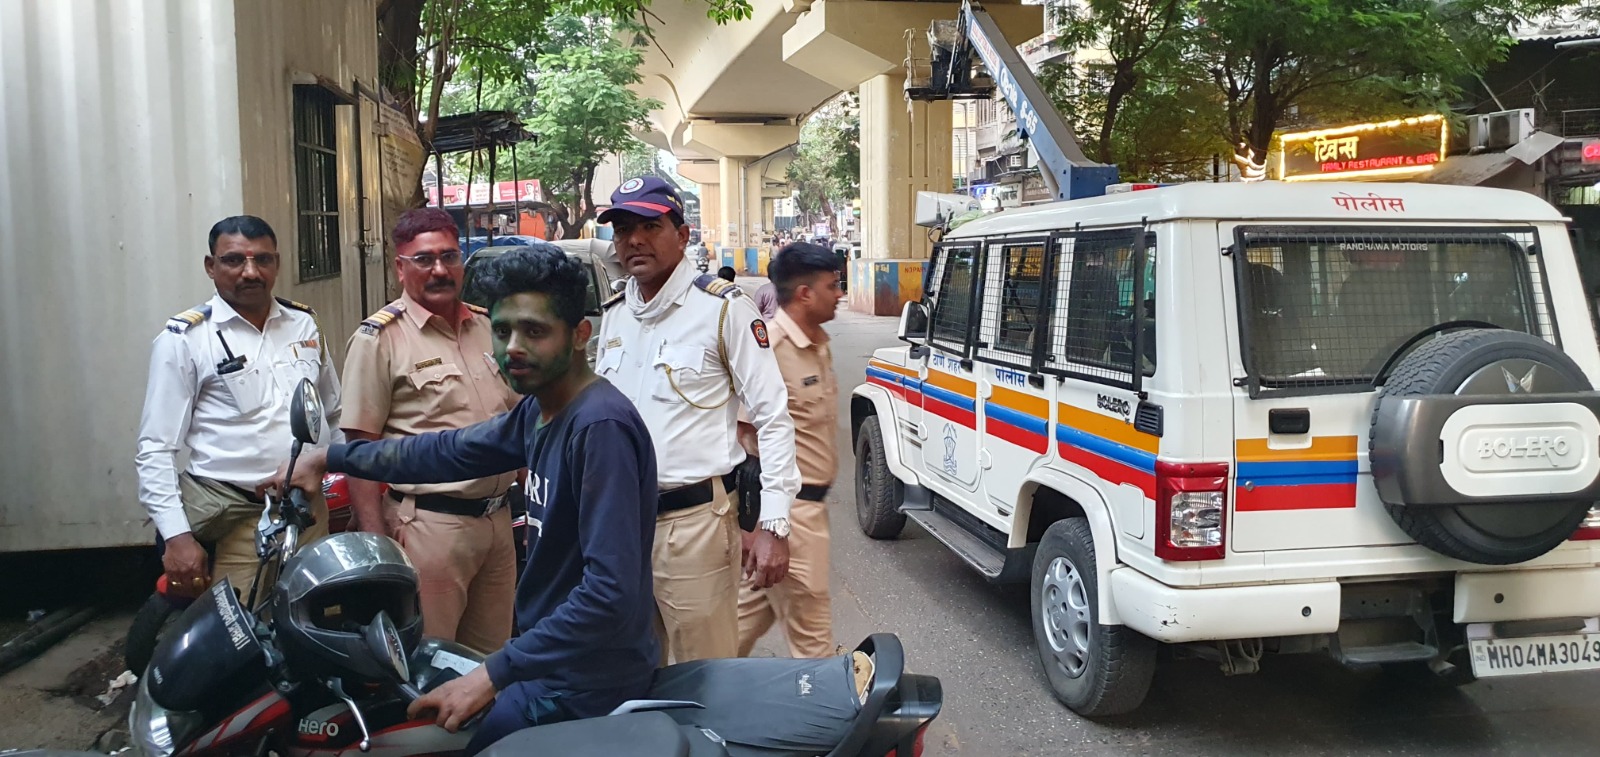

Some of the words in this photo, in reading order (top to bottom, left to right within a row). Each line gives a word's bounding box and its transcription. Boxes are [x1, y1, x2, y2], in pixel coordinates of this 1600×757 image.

[1321, 161, 1347, 172] FAMILY
[1347, 155, 1404, 169] RESTAURANT
[1405, 156, 1415, 164] &
[1331, 191, 1405, 212] पोलीस
[1391, 243, 1428, 251] MOTORS
[995, 365, 1026, 388] पोलीस
[1097, 393, 1131, 417] BOLERO
[1478, 435, 1570, 467] BOLERO
[1486, 640, 1600, 669] MH04MA3049
[298, 718, 339, 737] Hero
